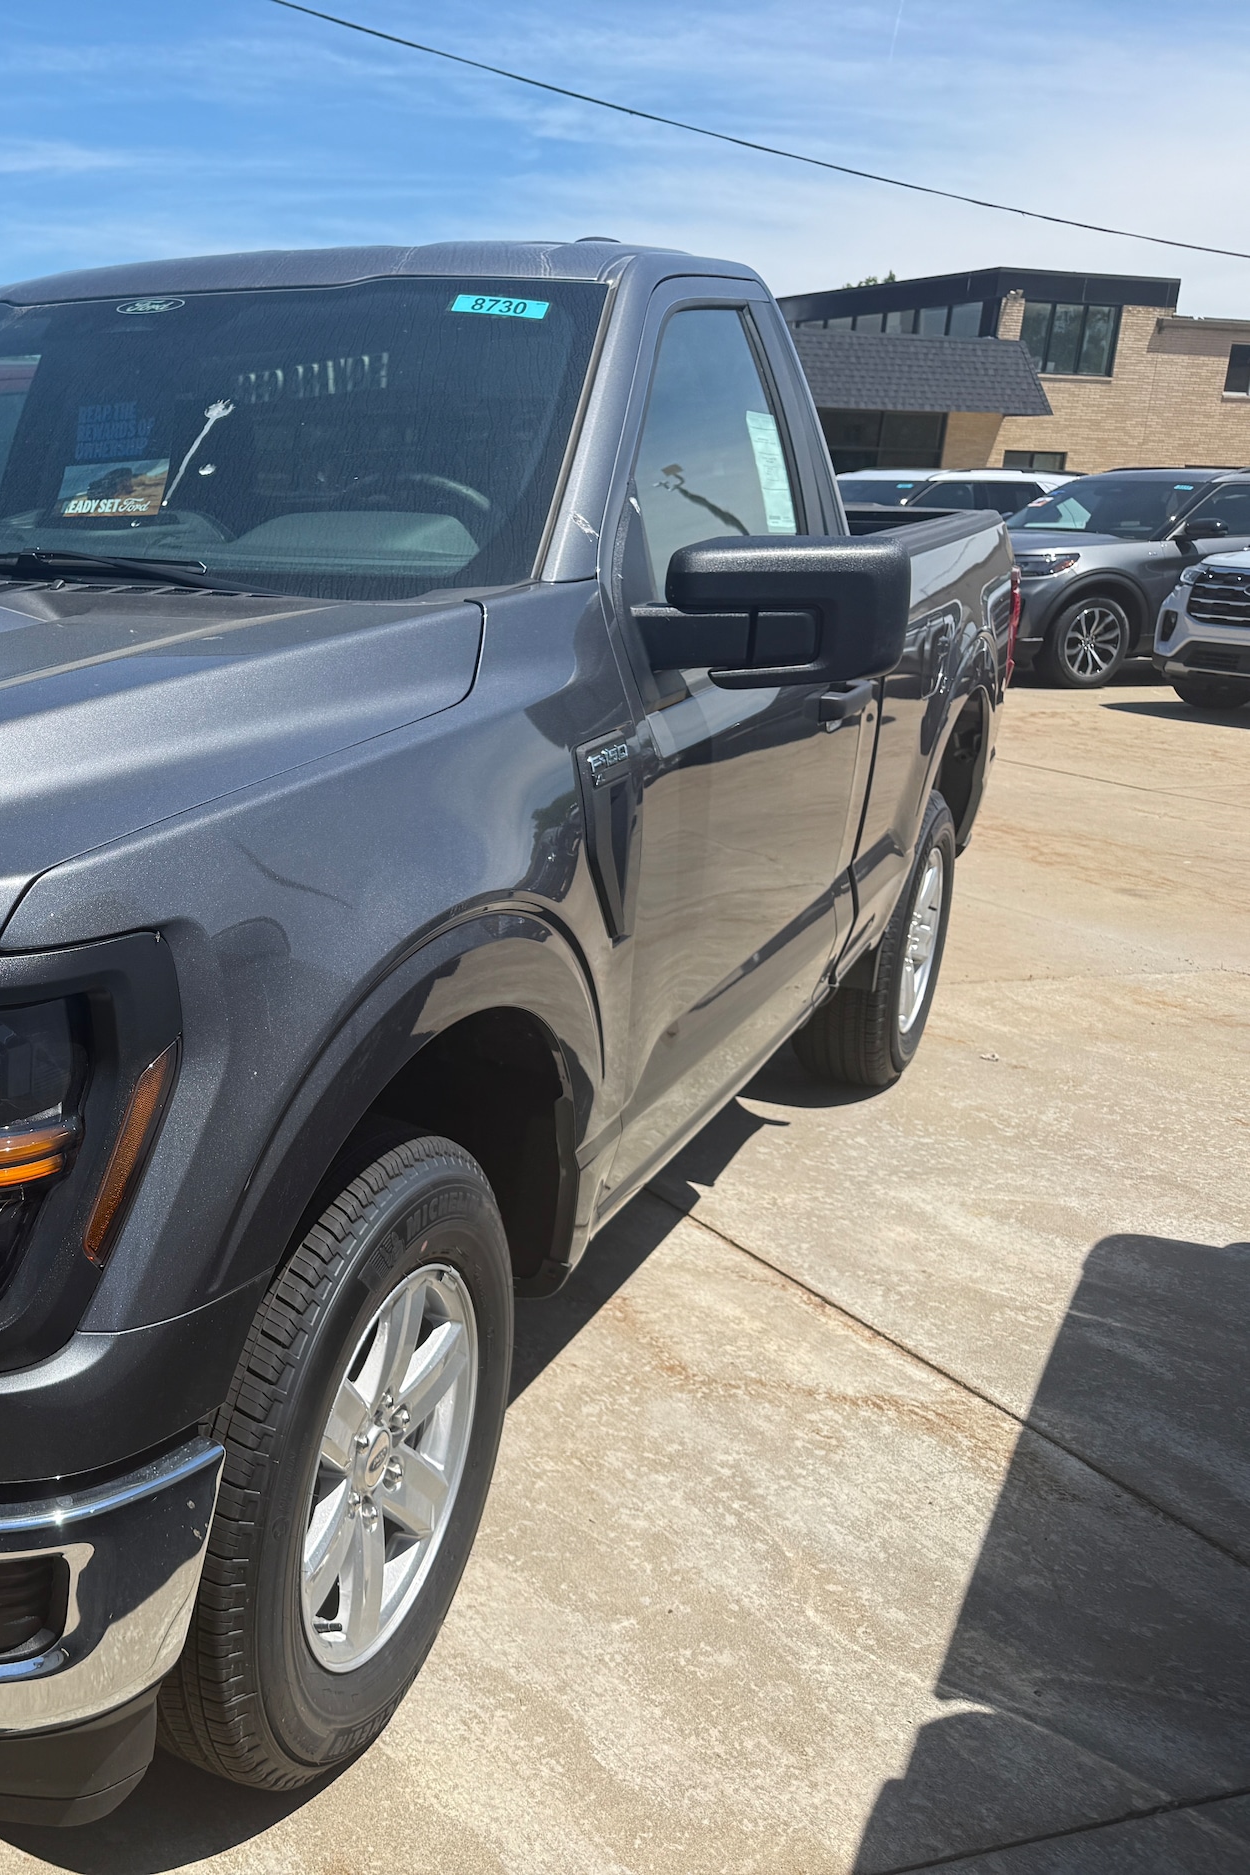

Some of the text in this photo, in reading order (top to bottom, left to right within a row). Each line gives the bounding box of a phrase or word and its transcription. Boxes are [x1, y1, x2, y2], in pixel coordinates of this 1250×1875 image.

[125, 298, 175, 312] Ford
[471, 298, 528, 315] 8730
[61, 497, 151, 514] READY SET Ford
